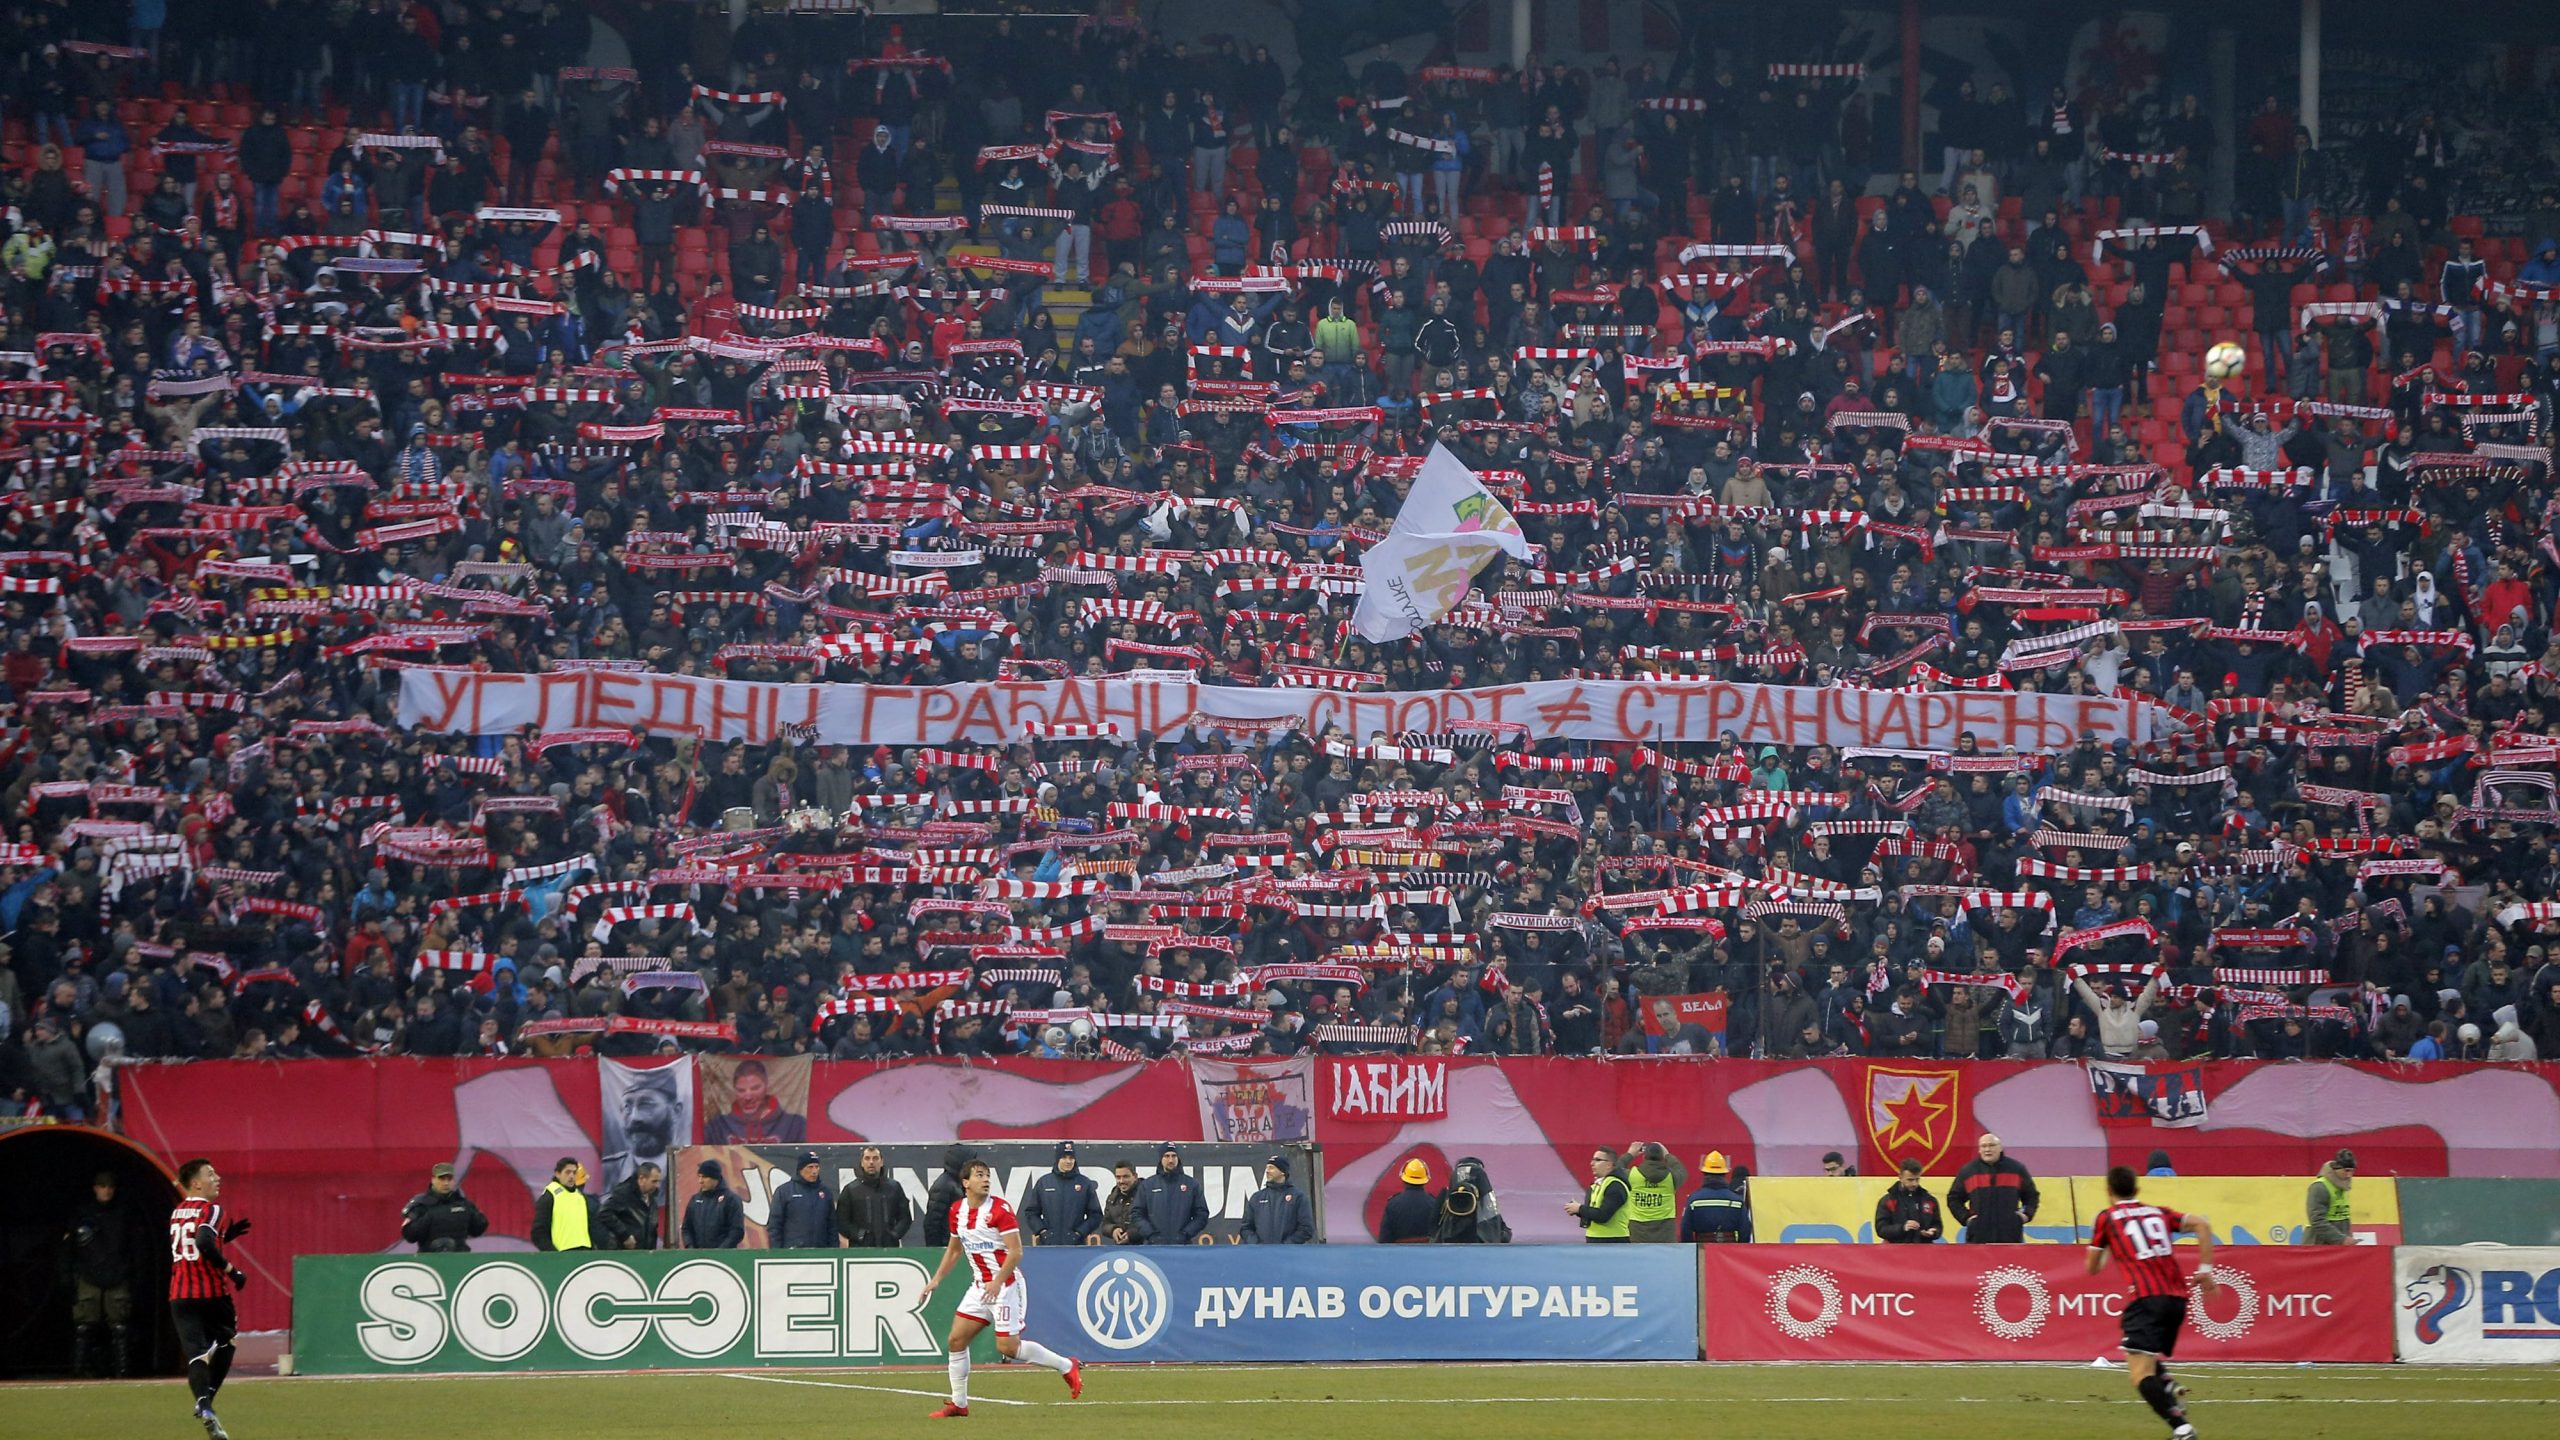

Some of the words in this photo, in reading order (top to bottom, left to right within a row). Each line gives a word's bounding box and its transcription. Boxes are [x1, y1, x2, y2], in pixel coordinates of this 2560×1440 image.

[1202, 382, 1229, 391] ЦРВЕНА
[1239, 383, 1263, 392] ЗВЕЗДА
[1298, 564, 1324, 575] RED
[963, 589, 985, 602] RED
[988, 586, 1019, 600] STAR
[1503, 785, 1526, 799] RED
[674, 832, 733, 855] CRAZY
[1275, 880, 1308, 888] ЦРВЕНА
[1309, 879, 1340, 888] ЗВЕЗДА
[847, 970, 965, 992] ДЕЛИЈЕ
[1203, 1040, 1226, 1051] RED
[1634, 1192, 1663, 1207] PHOTO
[169, 1221, 200, 1263] 26
[2124, 1216, 2173, 1260] 19
[356, 1257, 943, 1366] SOCCER
[1194, 1285, 1346, 1328] ДУНАВ
[1358, 1284, 1639, 1319] ОСИГУРАЊЕ
